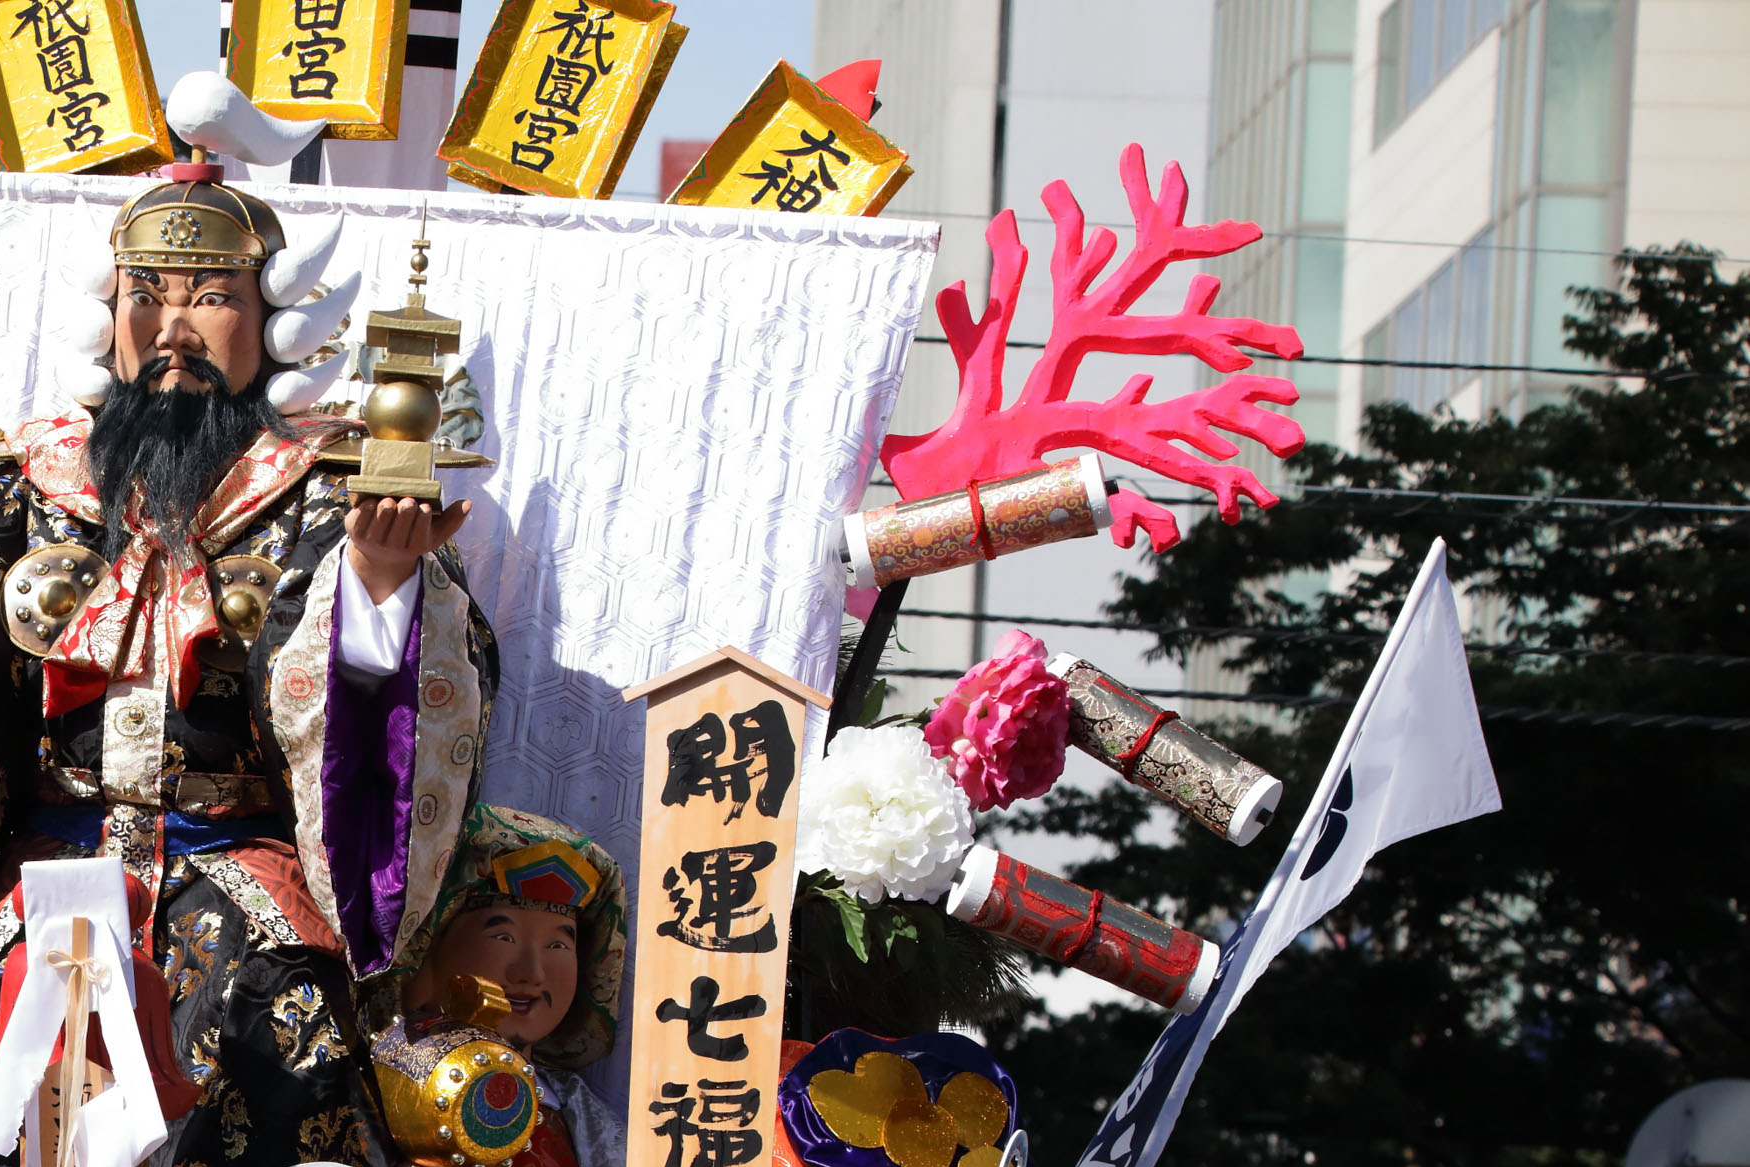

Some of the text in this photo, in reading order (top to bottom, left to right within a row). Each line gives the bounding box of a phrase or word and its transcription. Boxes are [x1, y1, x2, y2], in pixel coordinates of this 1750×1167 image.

[11, 0, 110, 152] 祇園宮
[511, 5, 615, 174] 祇園宮
